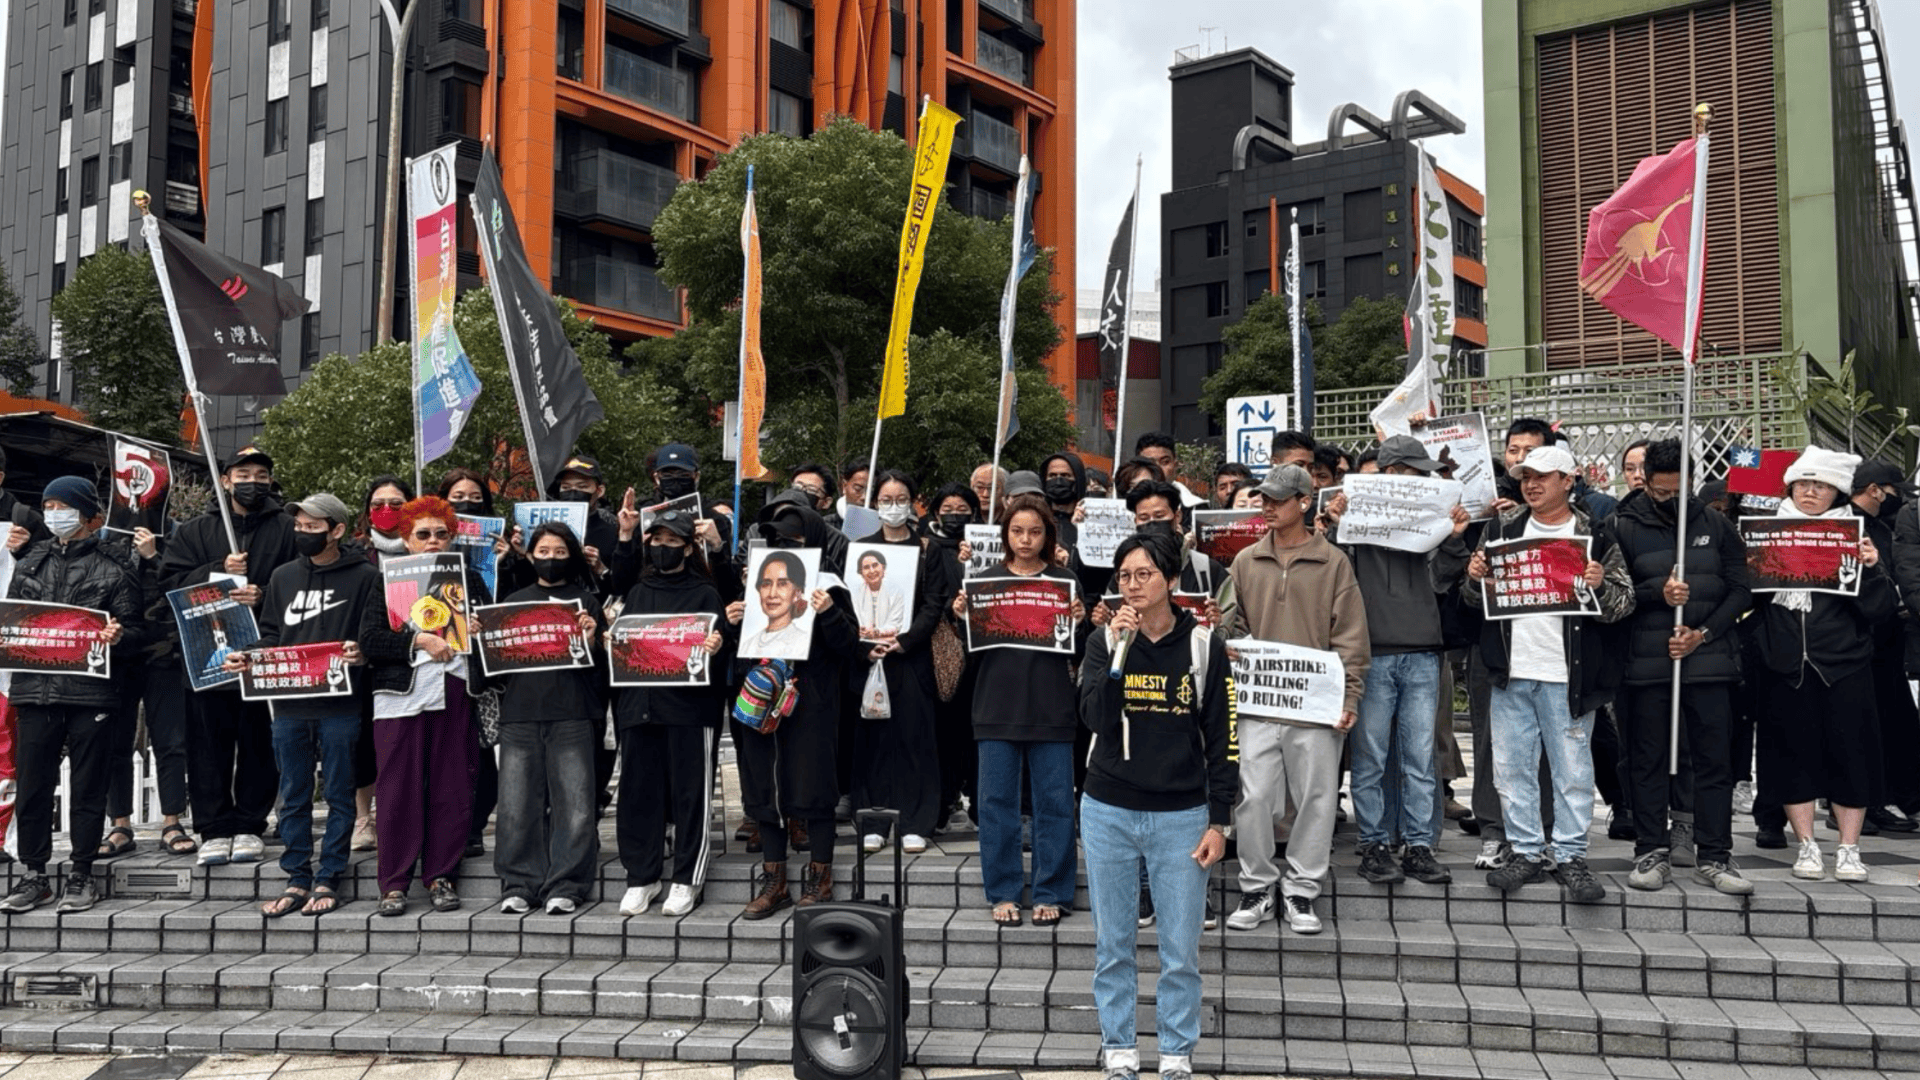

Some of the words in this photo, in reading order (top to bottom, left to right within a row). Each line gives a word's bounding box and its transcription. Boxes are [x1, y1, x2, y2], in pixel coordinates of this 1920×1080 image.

[116, 440, 155, 498] 5
[1254, 659, 1327, 674] AIRSTRIKE!
[1124, 674, 1168, 690] MNESTY
[1253, 673, 1310, 692] KILLING!
[1252, 691, 1304, 710] RULING!
